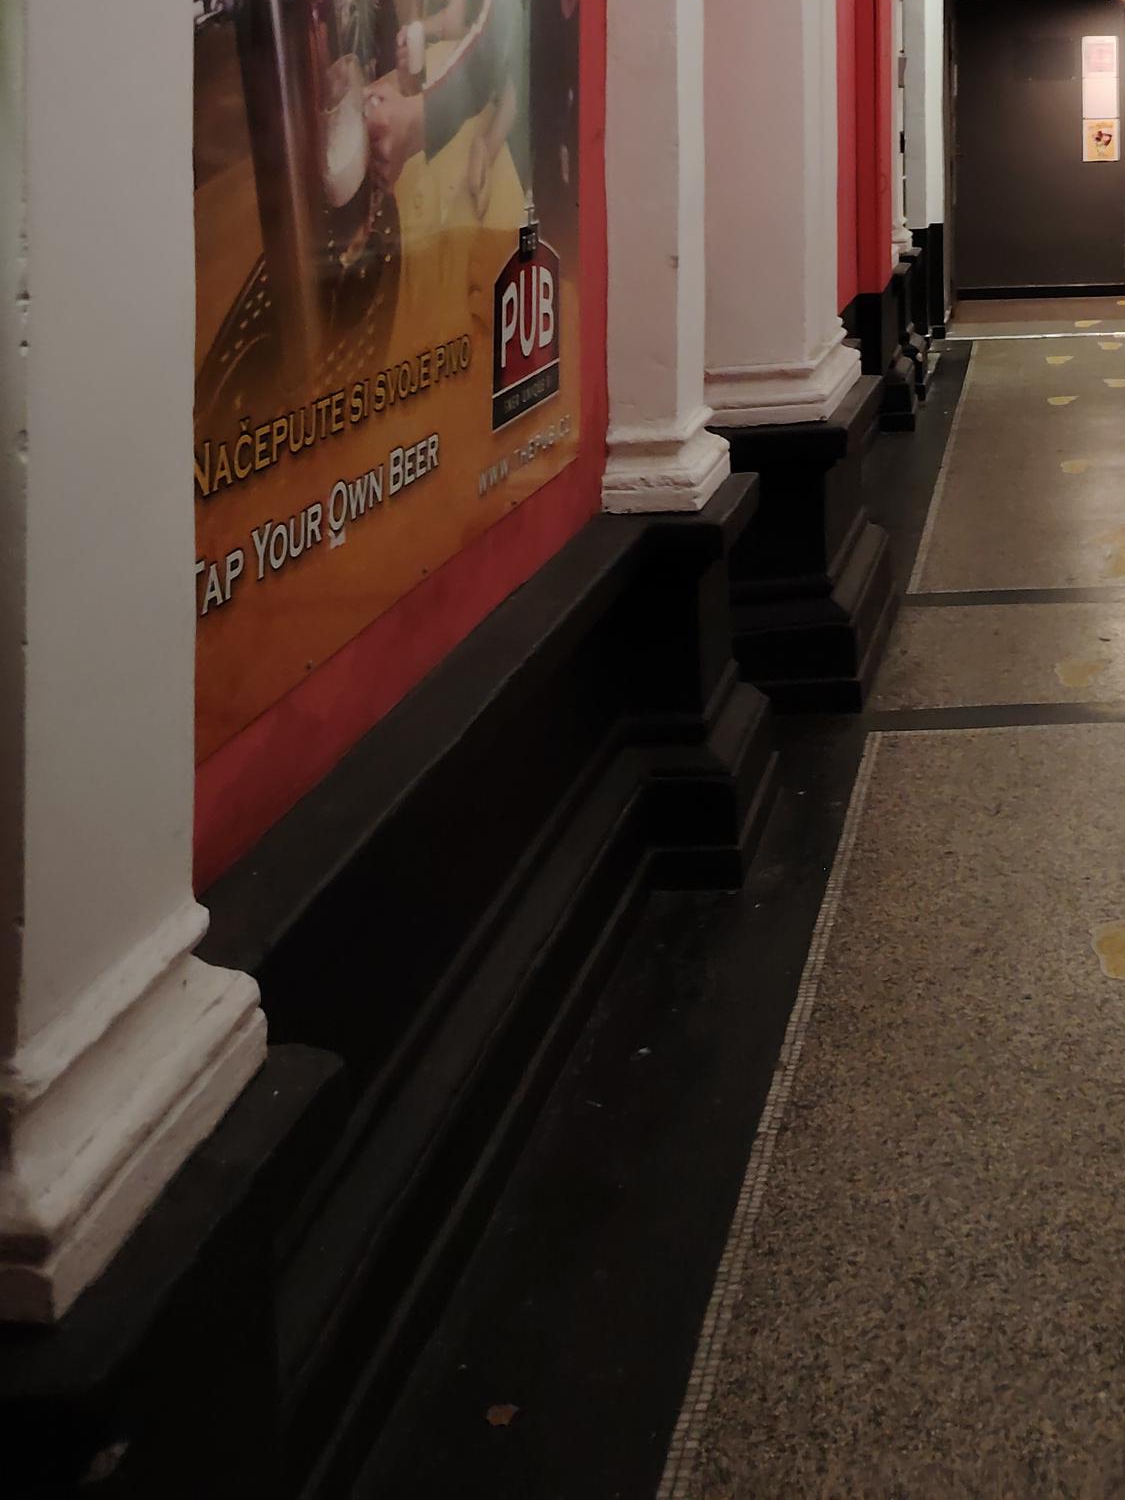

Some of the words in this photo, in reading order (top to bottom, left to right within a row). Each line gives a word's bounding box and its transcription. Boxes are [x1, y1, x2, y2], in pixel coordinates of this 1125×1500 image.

[501, 265, 554, 368] PUB
[350, 380, 370, 423] SI
[374, 352, 431, 413] SVOJE
[434, 334, 470, 382] PIVO
[251, 503, 323, 582] YOUR
[328, 464, 384, 531] OWN
[389, 433, 440, 497] BEER
